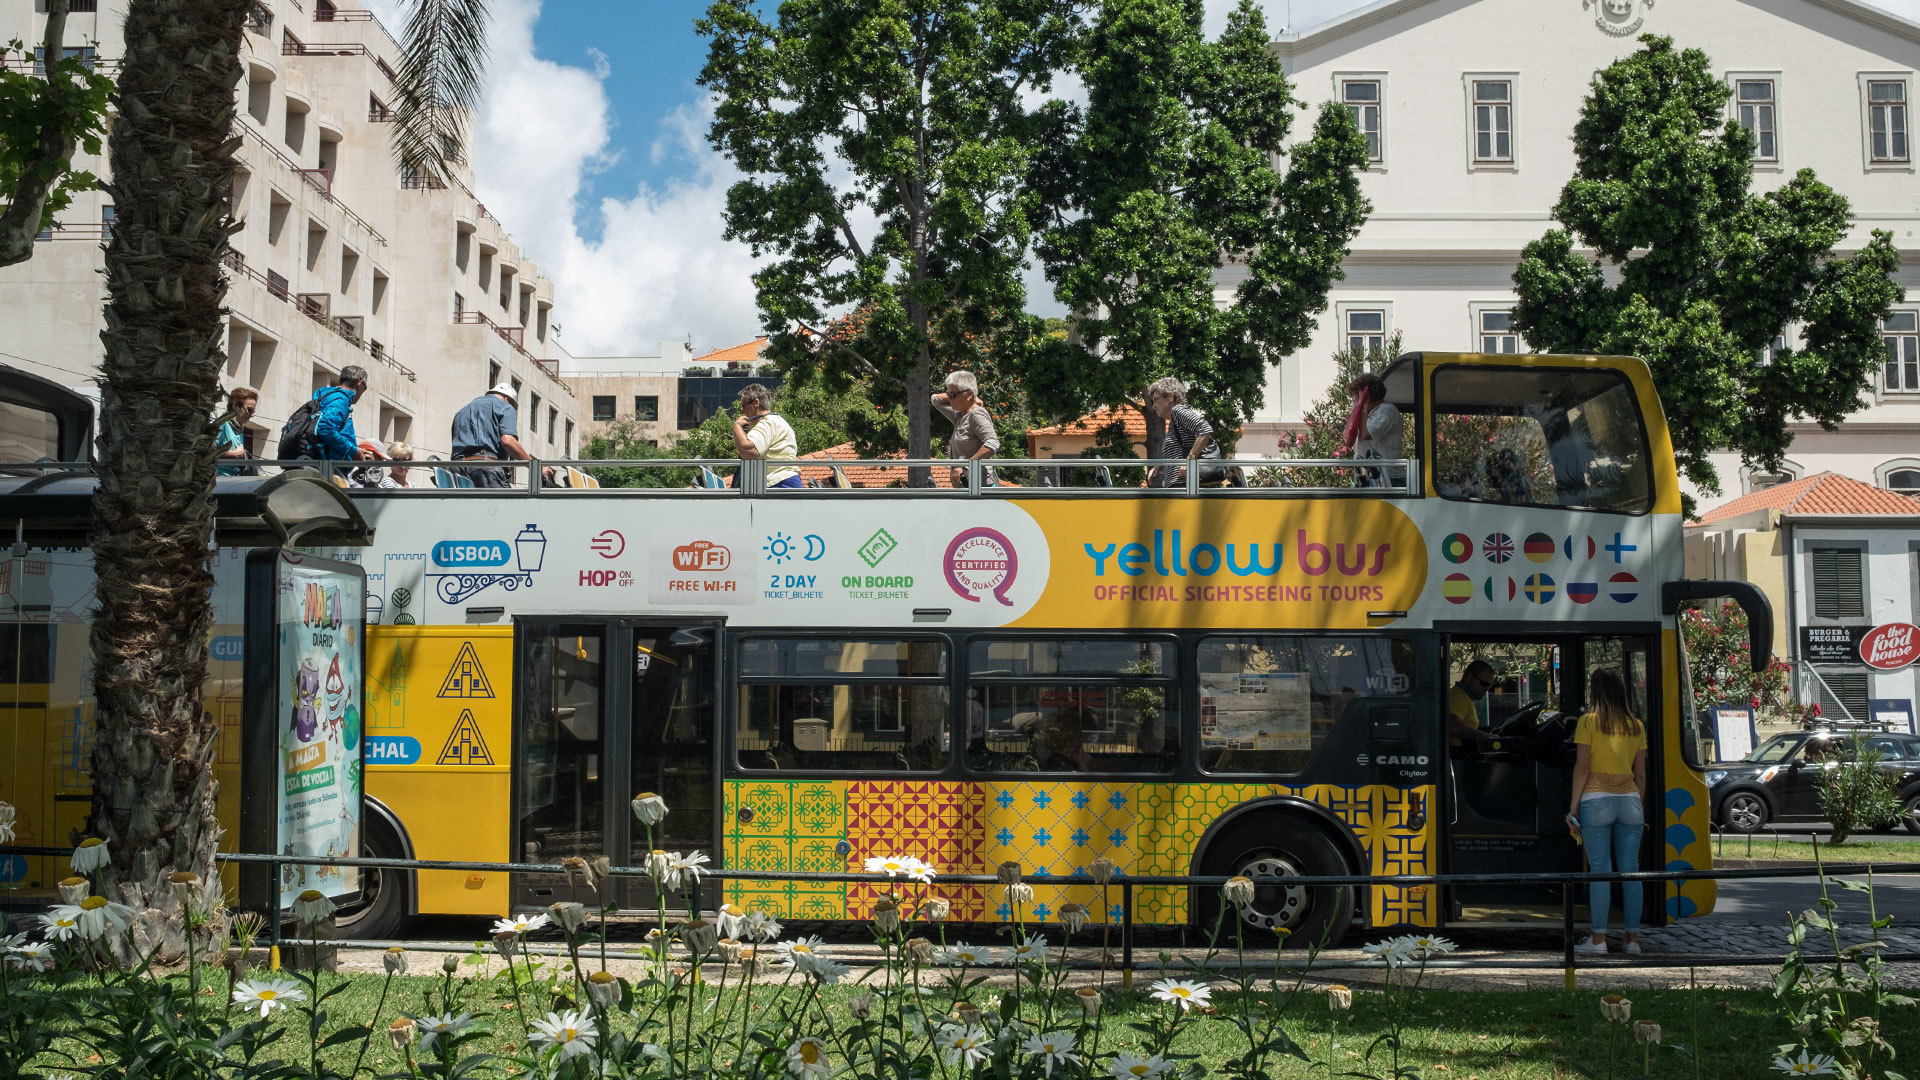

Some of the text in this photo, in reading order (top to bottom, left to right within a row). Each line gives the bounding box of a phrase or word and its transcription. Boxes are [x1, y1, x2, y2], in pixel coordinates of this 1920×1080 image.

[440, 545, 503, 562] LISBOA
[956, 539, 1005, 559] EXCELLENCE
[1298, 529, 1390, 577] bus
[955, 561, 1006, 569] CERTIFIED
[579, 570, 616, 587] HOP
[619, 571, 632, 579] ON
[771, 575, 817, 588] 2 DAY
[956, 571, 1005, 590] AND QUALITY
[619, 579, 635, 587] OFF
[669, 581, 736, 591] FREE WI-FI
[841, 576, 914, 588] ON BOARD
[764, 591, 823, 600] TICKET_BILHETE
[848, 591, 909, 600] TICKET_BILHETE
[1094, 585, 1384, 602] OFFICIAL SIGHTSEEING TOURS
[1887, 625, 1905, 638] the
[1872, 627, 1913, 652] food
[1870, 645, 1912, 662] house
[296, 745, 320, 767] MALTA
[1376, 755, 1429, 765] CAMO
[1399, 770, 1428, 778] Citytour
[301, 774, 311, 788] DE
